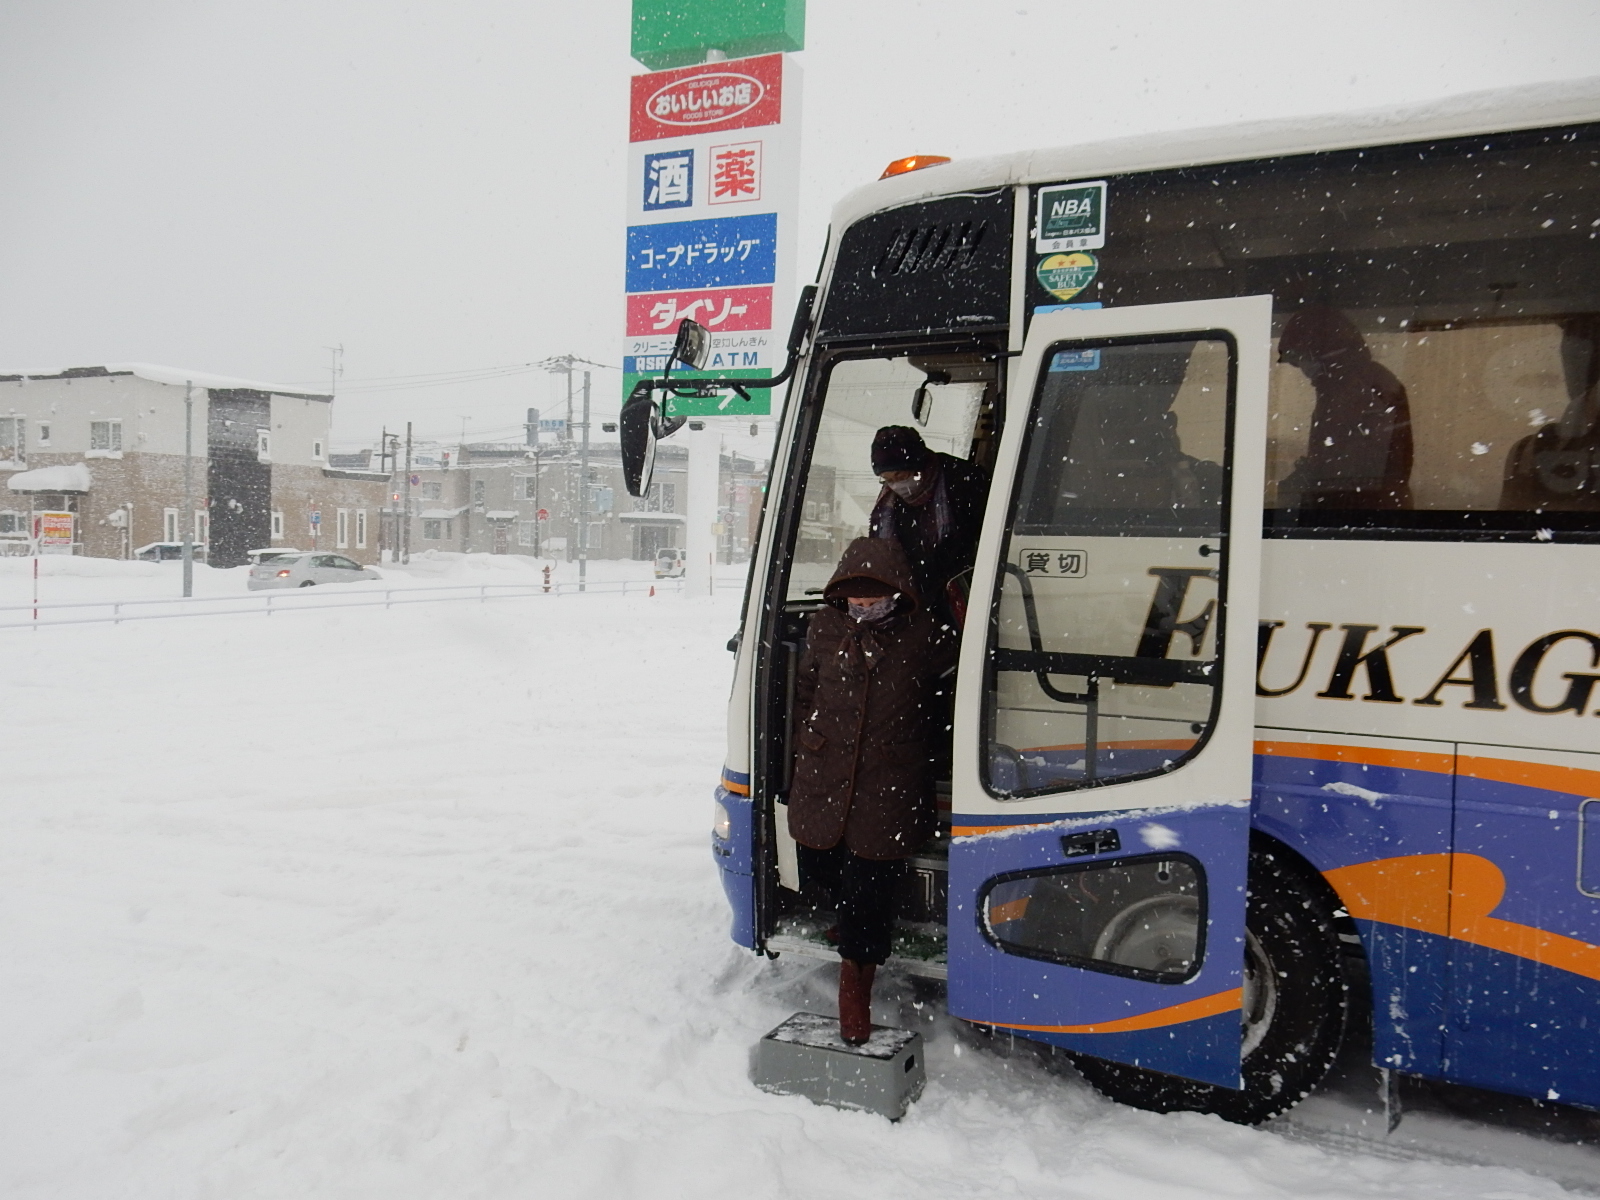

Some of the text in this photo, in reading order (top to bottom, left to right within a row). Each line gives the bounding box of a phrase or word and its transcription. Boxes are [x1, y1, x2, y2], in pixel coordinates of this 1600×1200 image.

[654, 83, 752, 116] おいしいお店
[647, 156, 689, 204] 酒
[714, 149, 755, 198] 薬
[1052, 198, 1091, 216] NBA
[640, 239, 760, 269] コープドラッグ
[1049, 272, 1084, 283] SAFETY
[1057, 281, 1076, 289] BUS
[649, 298, 748, 330] ダイソー
[633, 341, 677, 353] クリーニン
[712, 336, 768, 349] 空知しんきん
[712, 351, 758, 367] ATM
[1025, 551, 1082, 575] 貸切
[1113, 566, 1600, 718] FUKAG
